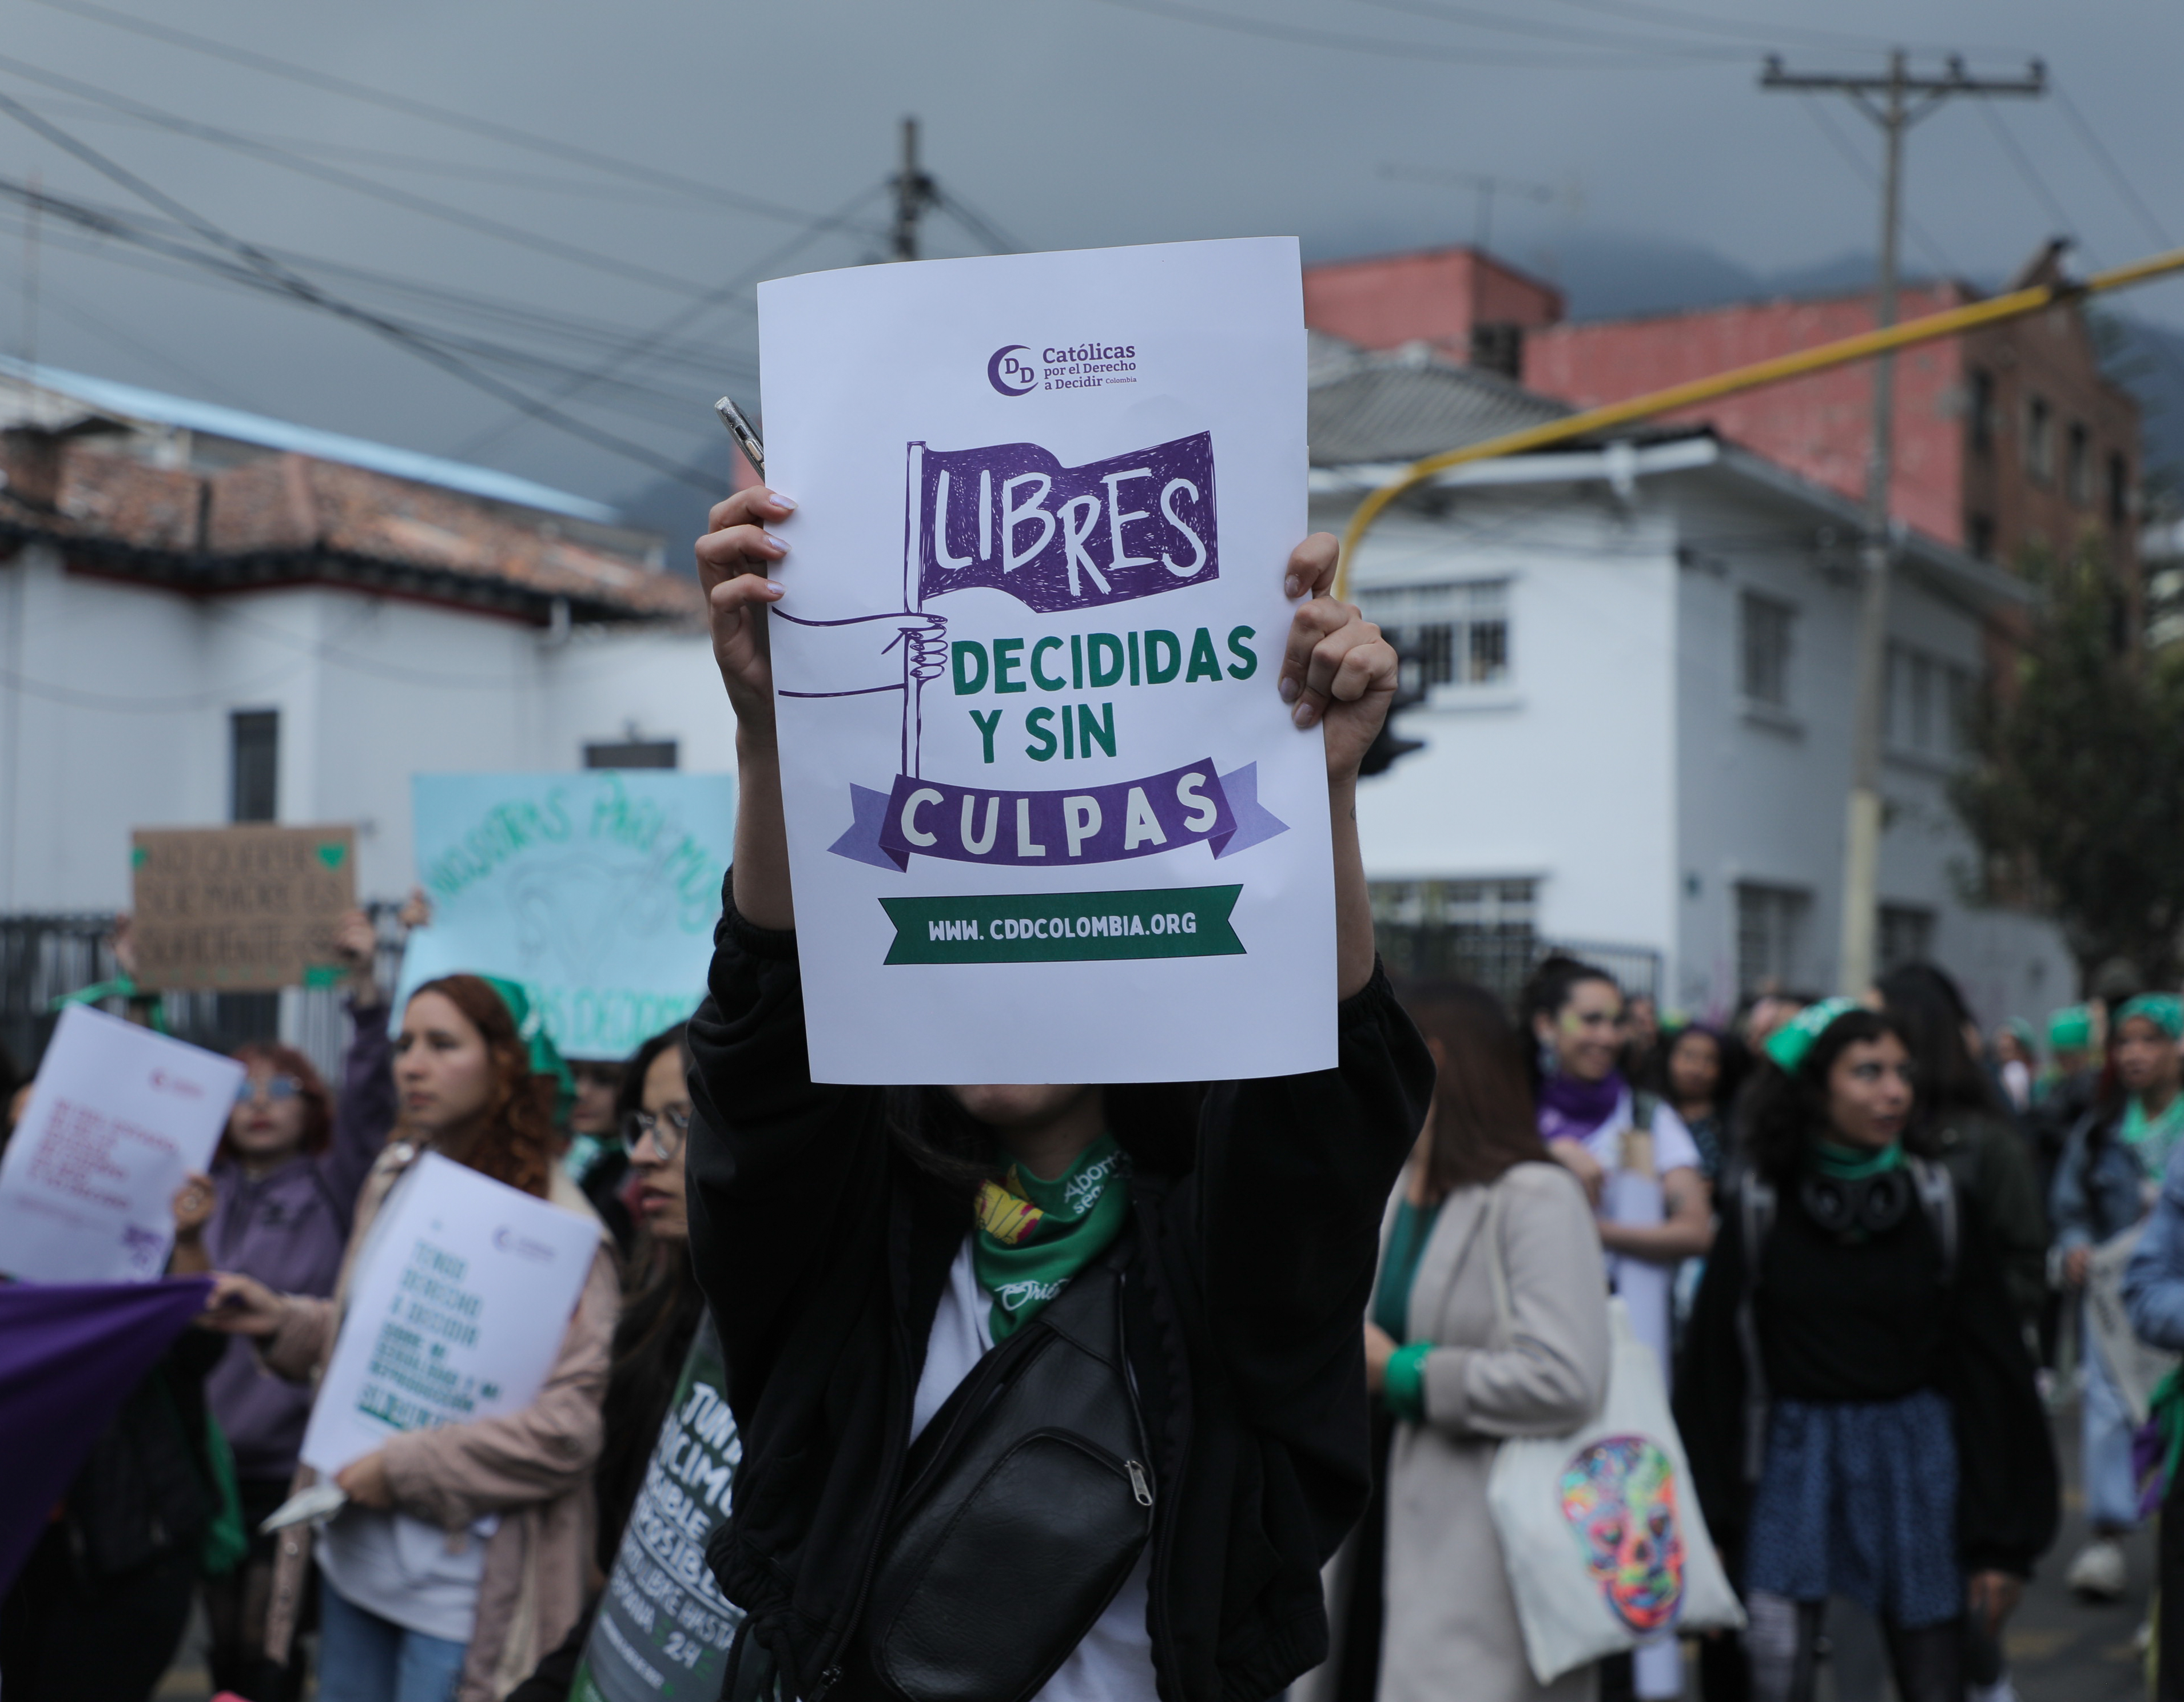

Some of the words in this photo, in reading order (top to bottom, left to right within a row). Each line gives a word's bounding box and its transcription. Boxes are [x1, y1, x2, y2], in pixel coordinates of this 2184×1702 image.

[1043, 343, 1136, 364] Católicas
[1044, 365, 1066, 379] por
[1069, 363, 1080, 375] el
[1083, 360, 1136, 374] Derecho
[1045, 382, 1052, 390] a
[1055, 376, 1103, 389] Decidir
[1105, 376, 1137, 384] Colombia
[934, 467, 1207, 597] LIBRES
[951, 625, 1258, 695] DECIDIDAS
[968, 709, 1003, 764] Y
[1025, 702, 1117, 762] SIN
[901, 772, 1218, 857] CULPAS
[929, 919, 985, 941] WWW.
[989, 912, 1197, 940] CDDCOLOMBIA.ORG
[662, 1630, 703, 1669] 24
